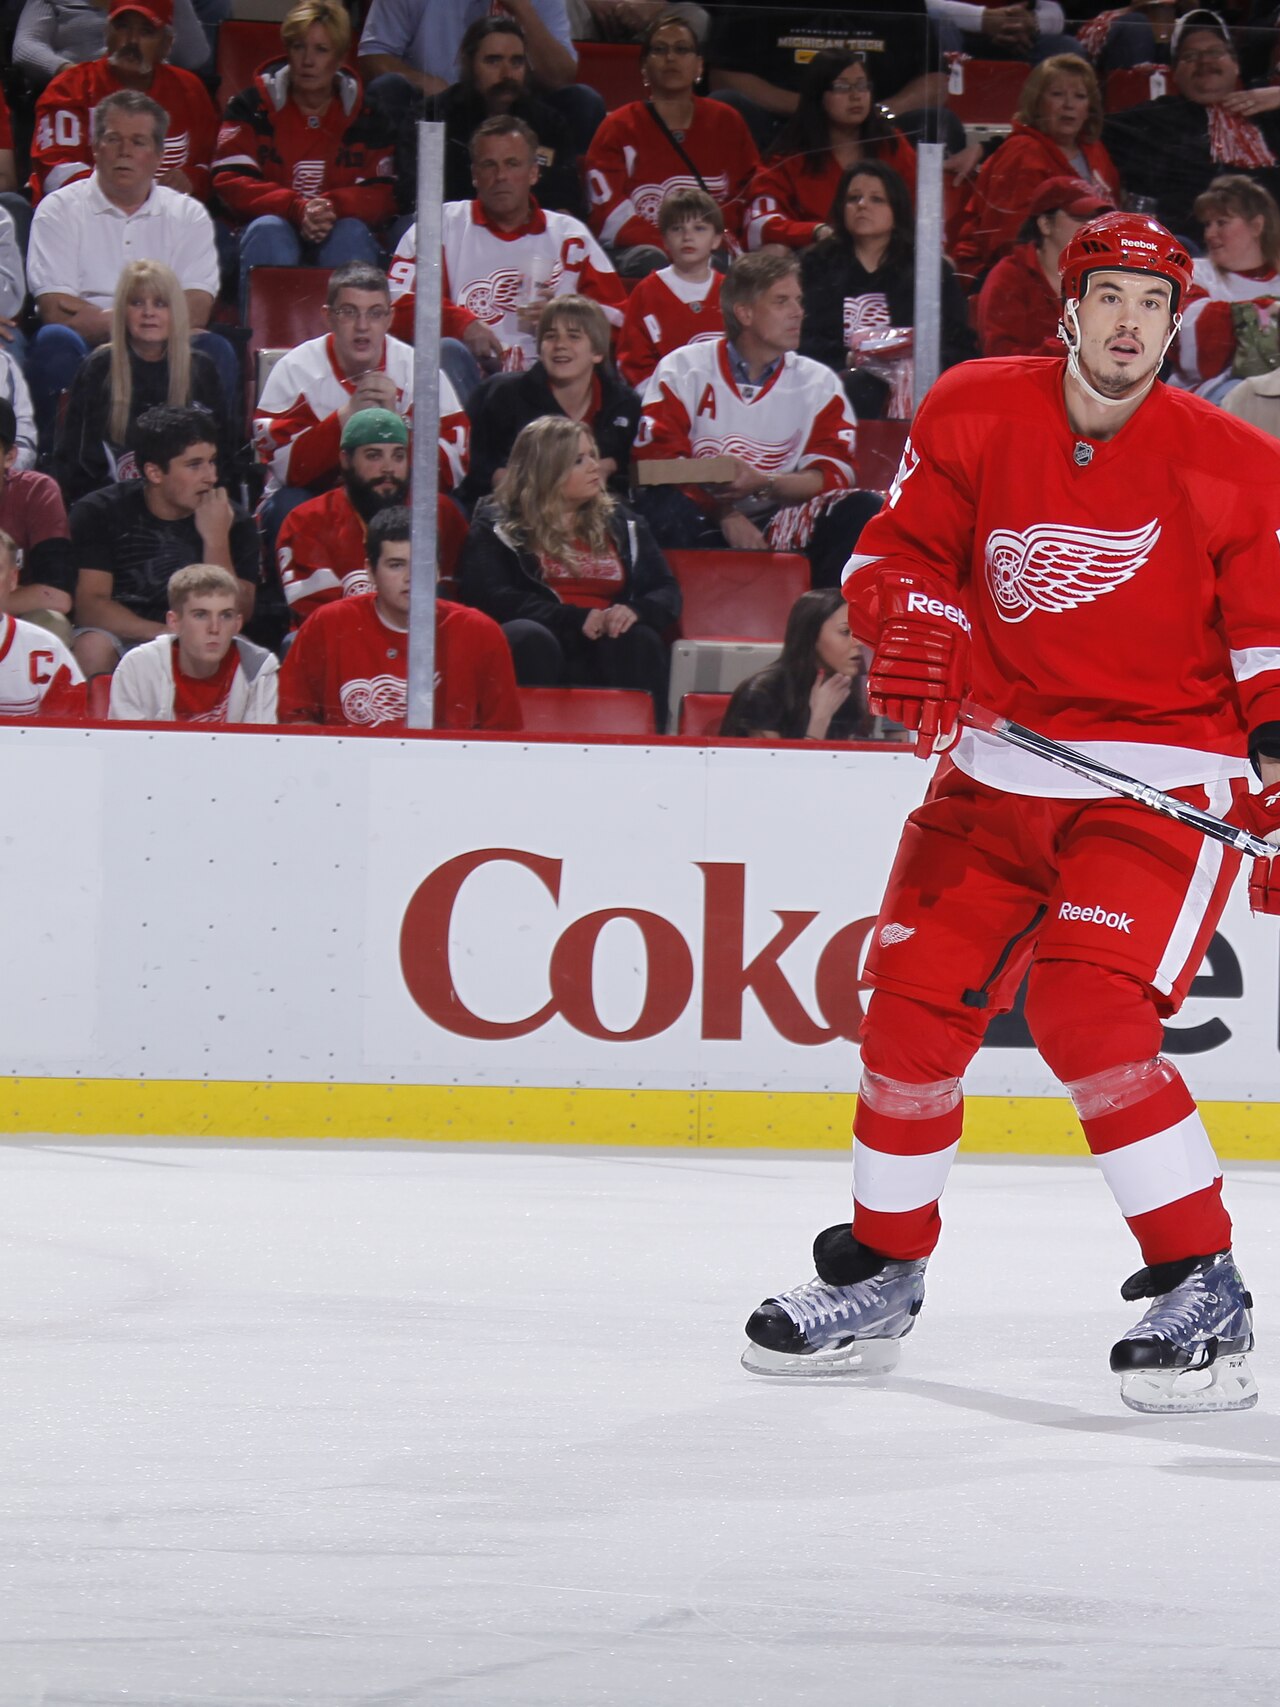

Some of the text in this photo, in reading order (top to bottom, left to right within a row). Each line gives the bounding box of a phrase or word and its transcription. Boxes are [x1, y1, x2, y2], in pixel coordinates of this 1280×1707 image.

[777, 37, 885, 52] MICHIGAN TECH
[36, 110, 80, 151] 40
[561, 236, 585, 273] C
[1120, 238, 1159, 252] Reebok
[697, 383, 717, 421] A
[907, 592, 972, 634] Reeb
[28, 650, 54, 685] C
[1058, 901, 1136, 935] Reebok
